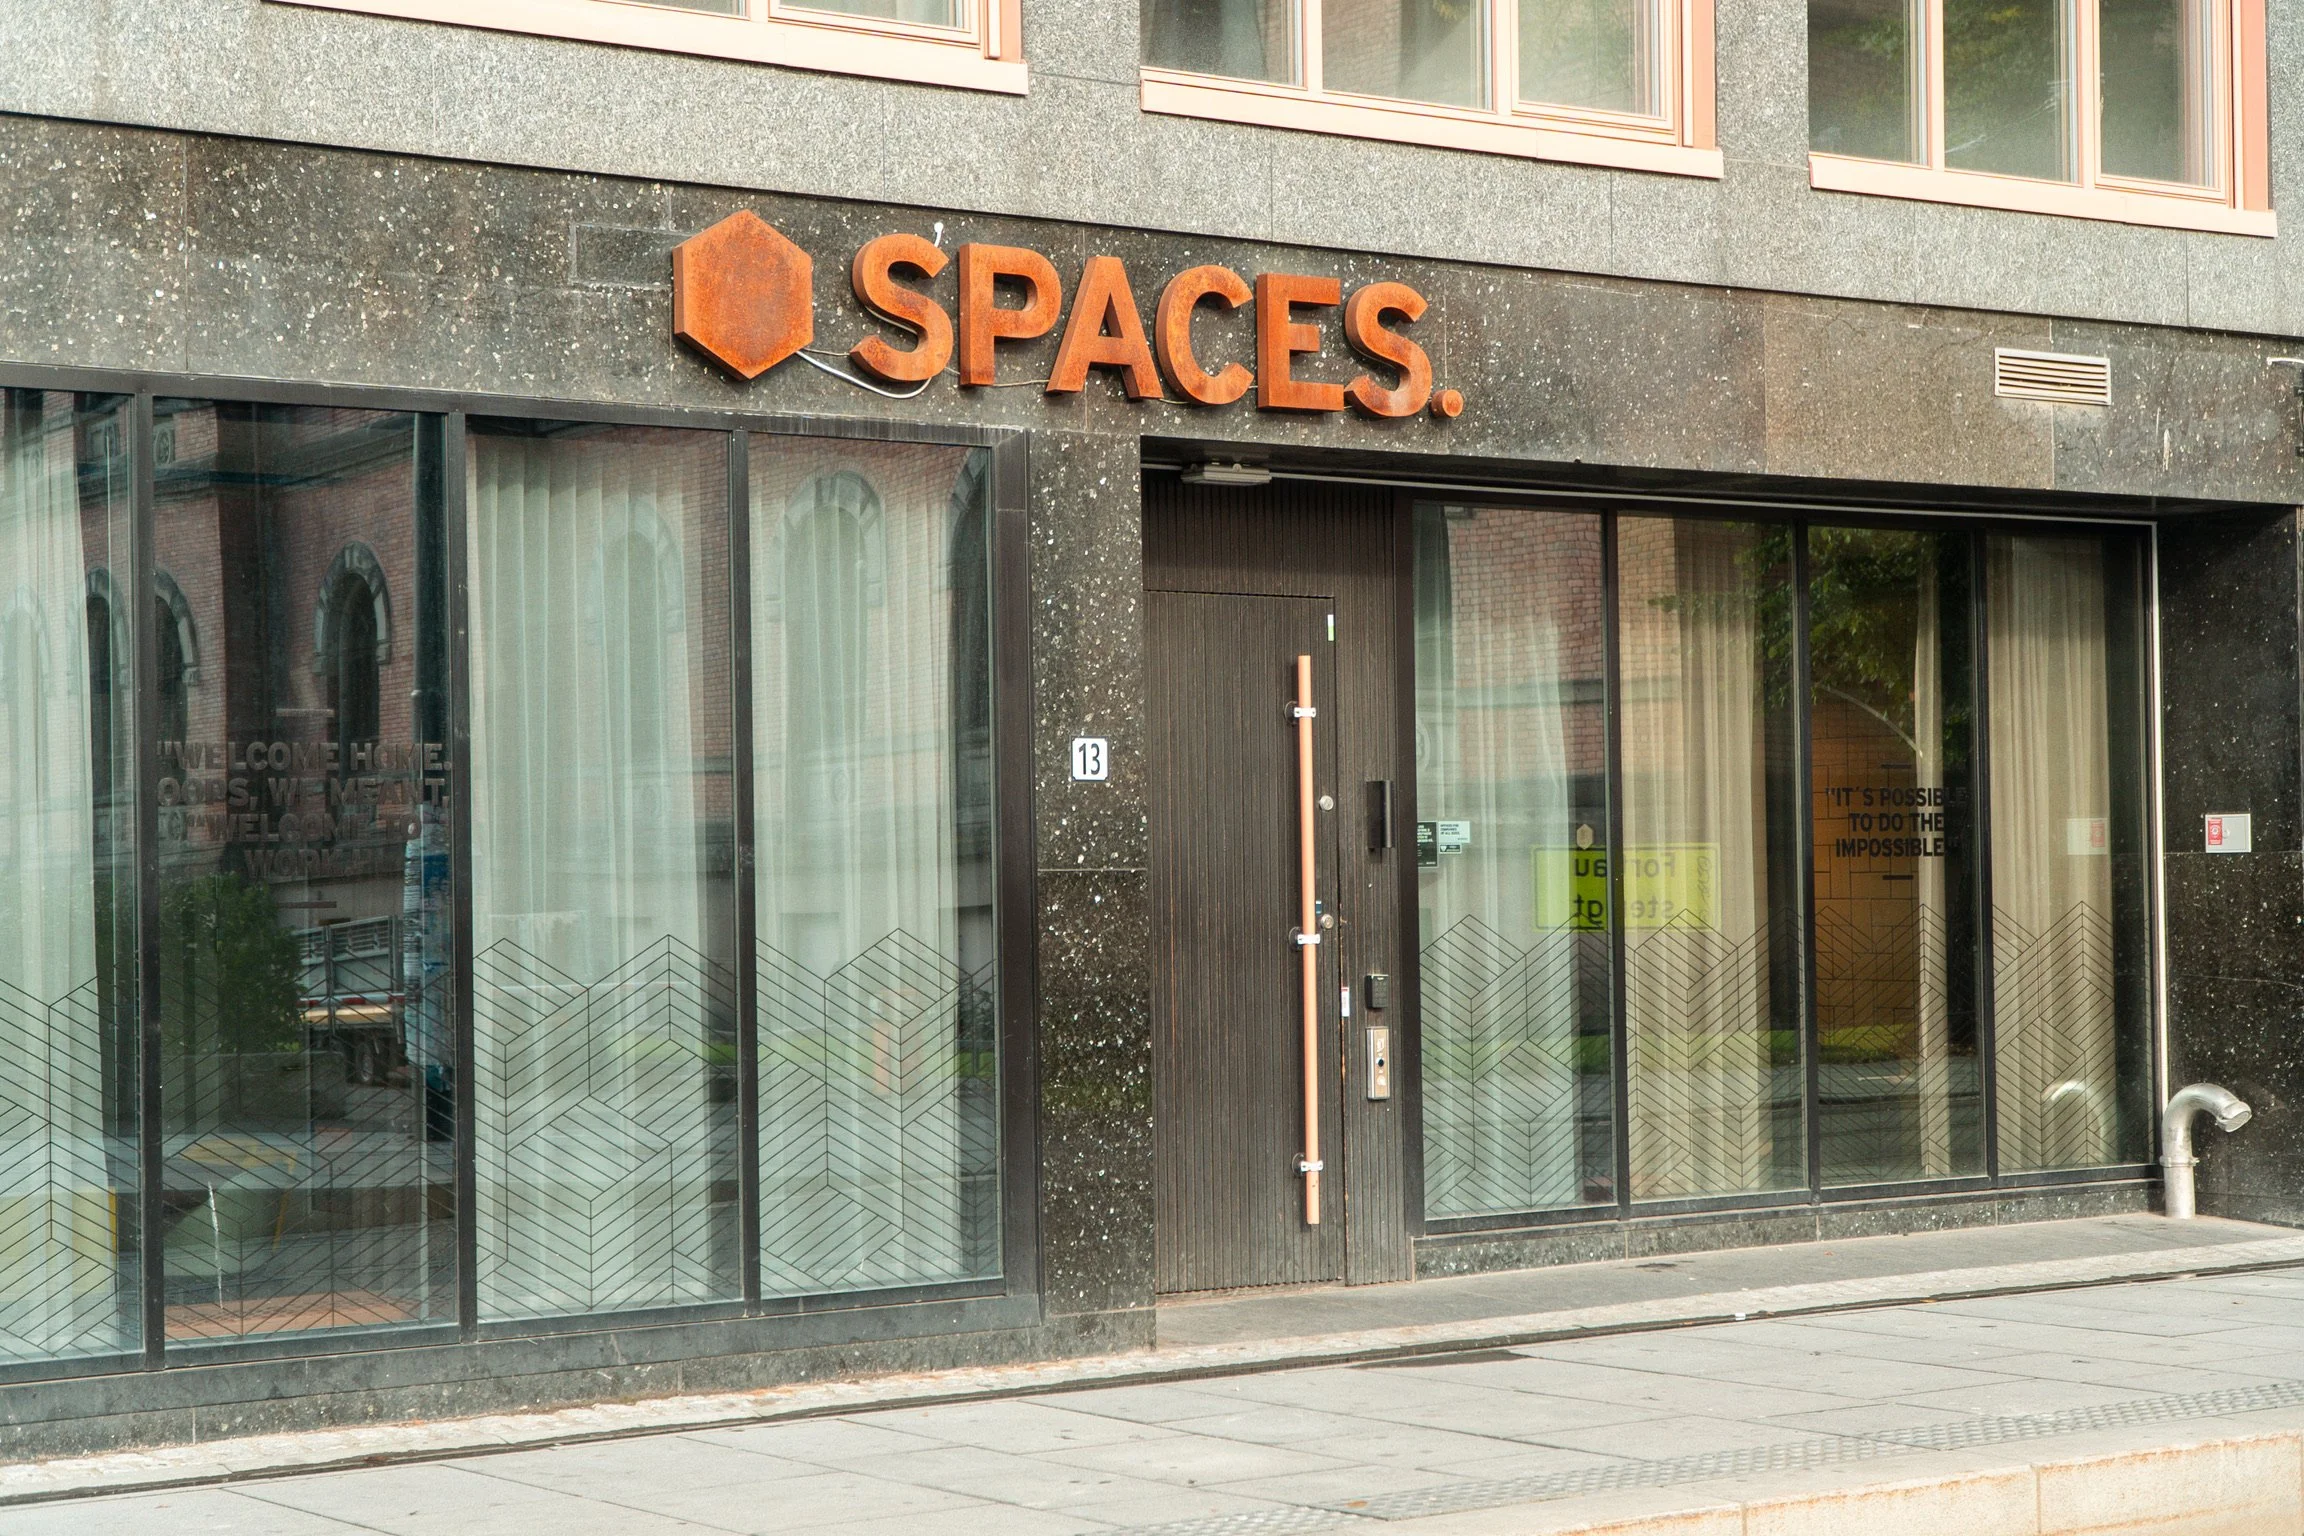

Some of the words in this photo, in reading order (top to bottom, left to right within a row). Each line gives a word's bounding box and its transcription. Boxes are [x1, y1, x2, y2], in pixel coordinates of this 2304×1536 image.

[850, 232, 1464, 420] SPACES.
[350, 742, 452, 771] HOME.
[1078, 743, 1101, 775] 13
[157, 777, 258, 808] OOPS,
[268, 777, 325, 806] WE
[1849, 813, 1873, 832] TO
[1879, 813, 1904, 832] DO
[1909, 813, 1945, 832] THE
